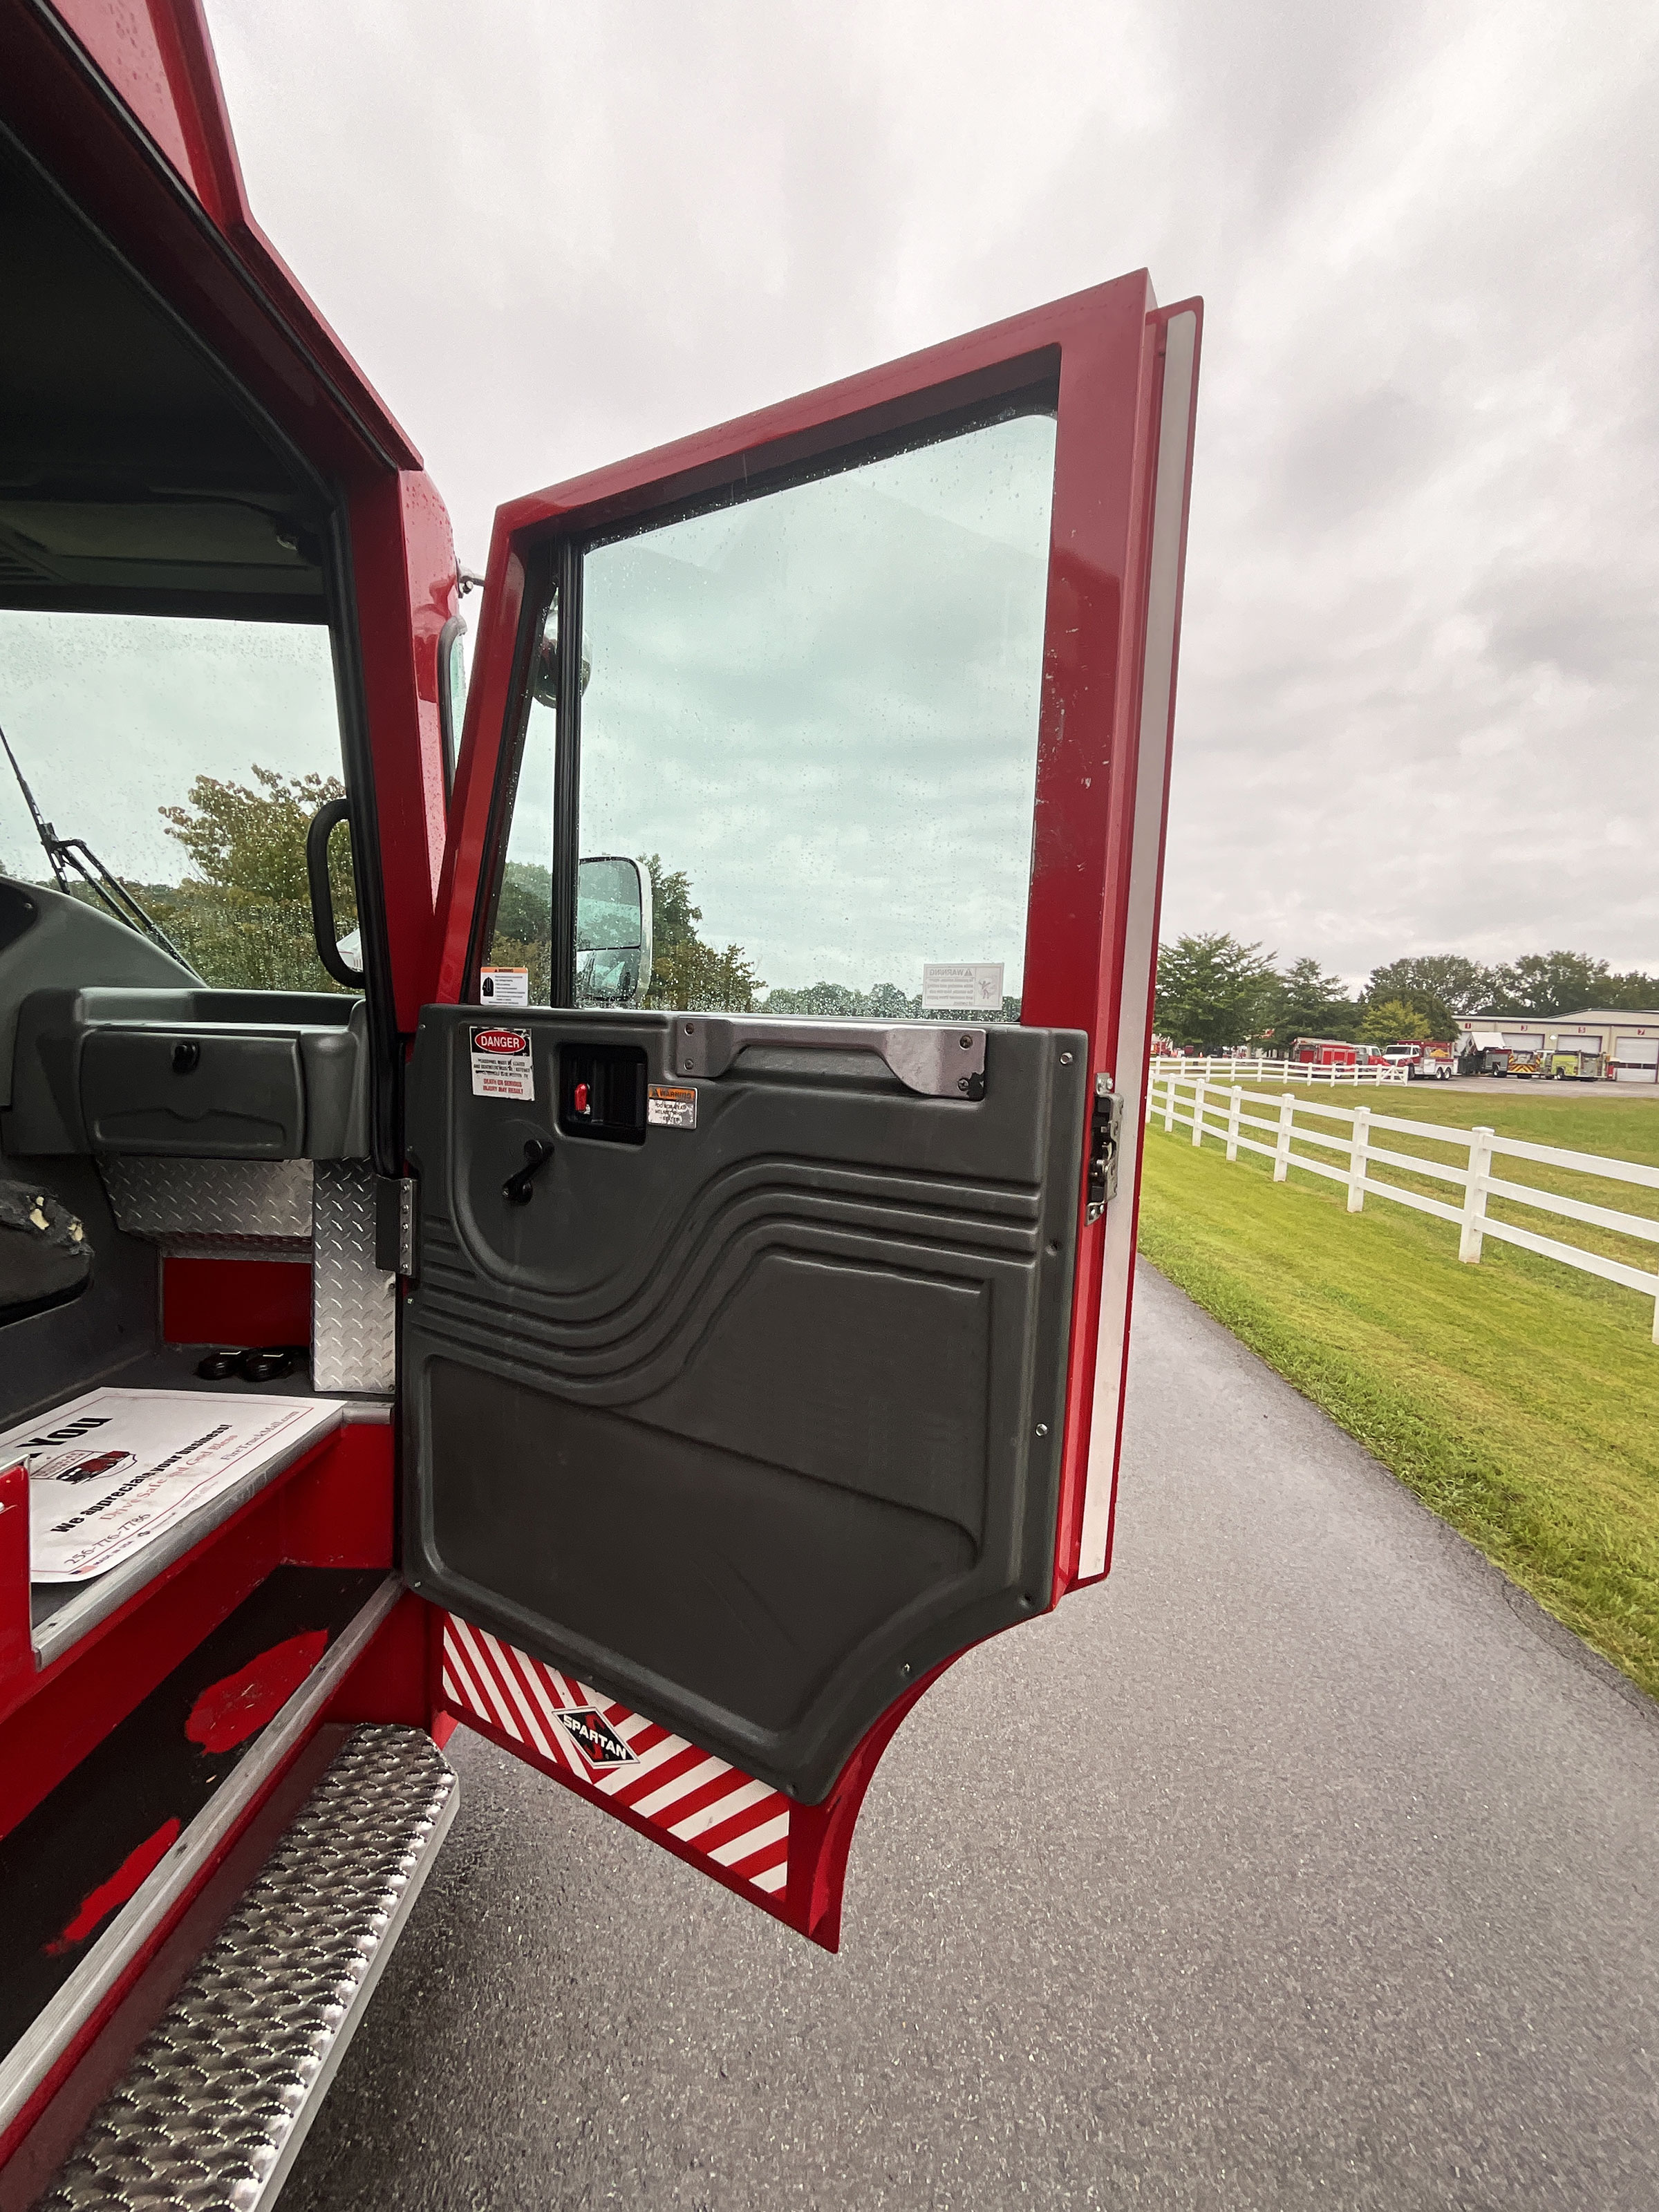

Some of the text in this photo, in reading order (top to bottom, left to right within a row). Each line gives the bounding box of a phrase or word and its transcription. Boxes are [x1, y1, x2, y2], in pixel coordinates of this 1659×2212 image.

[480, 1035, 520, 1049] DANGER
[15, 1417, 113, 1448] You
[220, 1410, 299, 1461] FireTruckMall.com
[50, 1515, 84, 1533] We
[80, 1471, 156, 1516] appreciate
[153, 1455, 182, 1473] your
[179, 1424, 233, 1455] business!
[99, 1497, 142, 1521] Drive
[137, 1479, 167, 1499] Safe
[186, 1451, 212, 1465] God
[208, 1434, 238, 1450] Bless
[64, 1513, 151, 1564] 256-776-7786
[562, 1714, 627, 1761] SPARTAN
